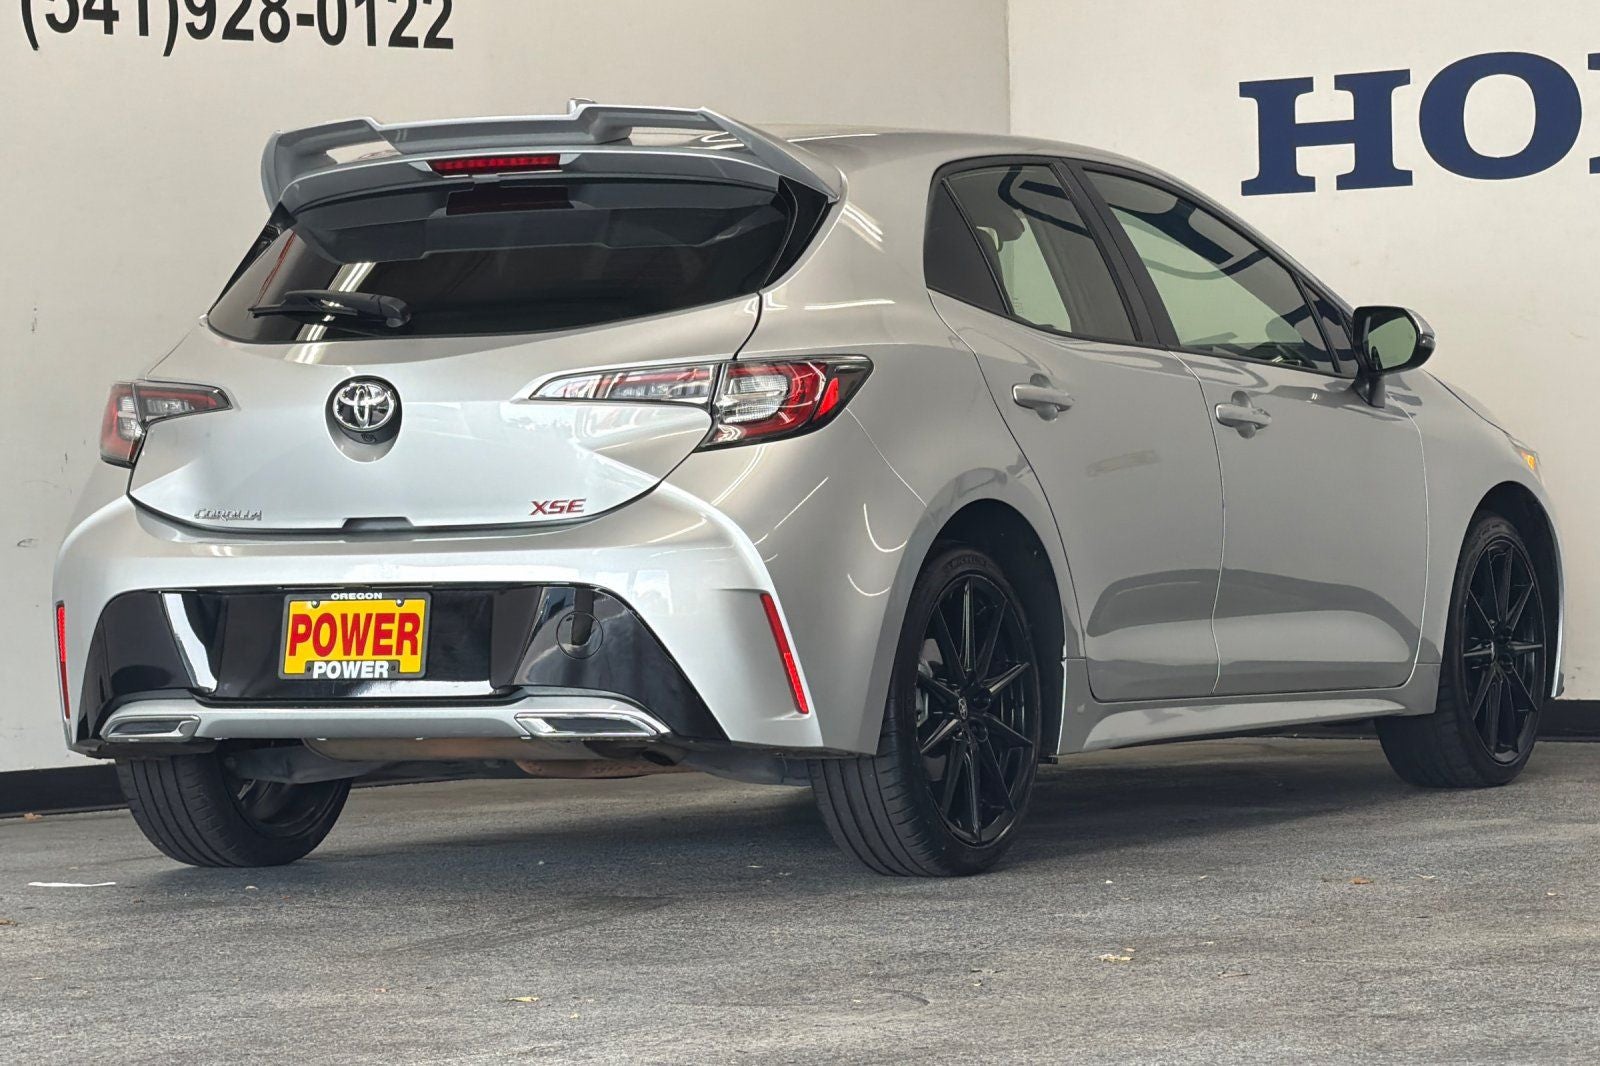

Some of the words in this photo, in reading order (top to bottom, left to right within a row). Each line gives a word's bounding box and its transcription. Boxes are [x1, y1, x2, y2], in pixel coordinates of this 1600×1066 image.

[1239, 51, 1600, 196] HO
[193, 507, 262, 521] COROLLA
[530, 498, 587, 516] XSE
[330, 591, 383, 600] OREGON
[288, 612, 421, 658] POWER
[312, 661, 389, 679] POWER
